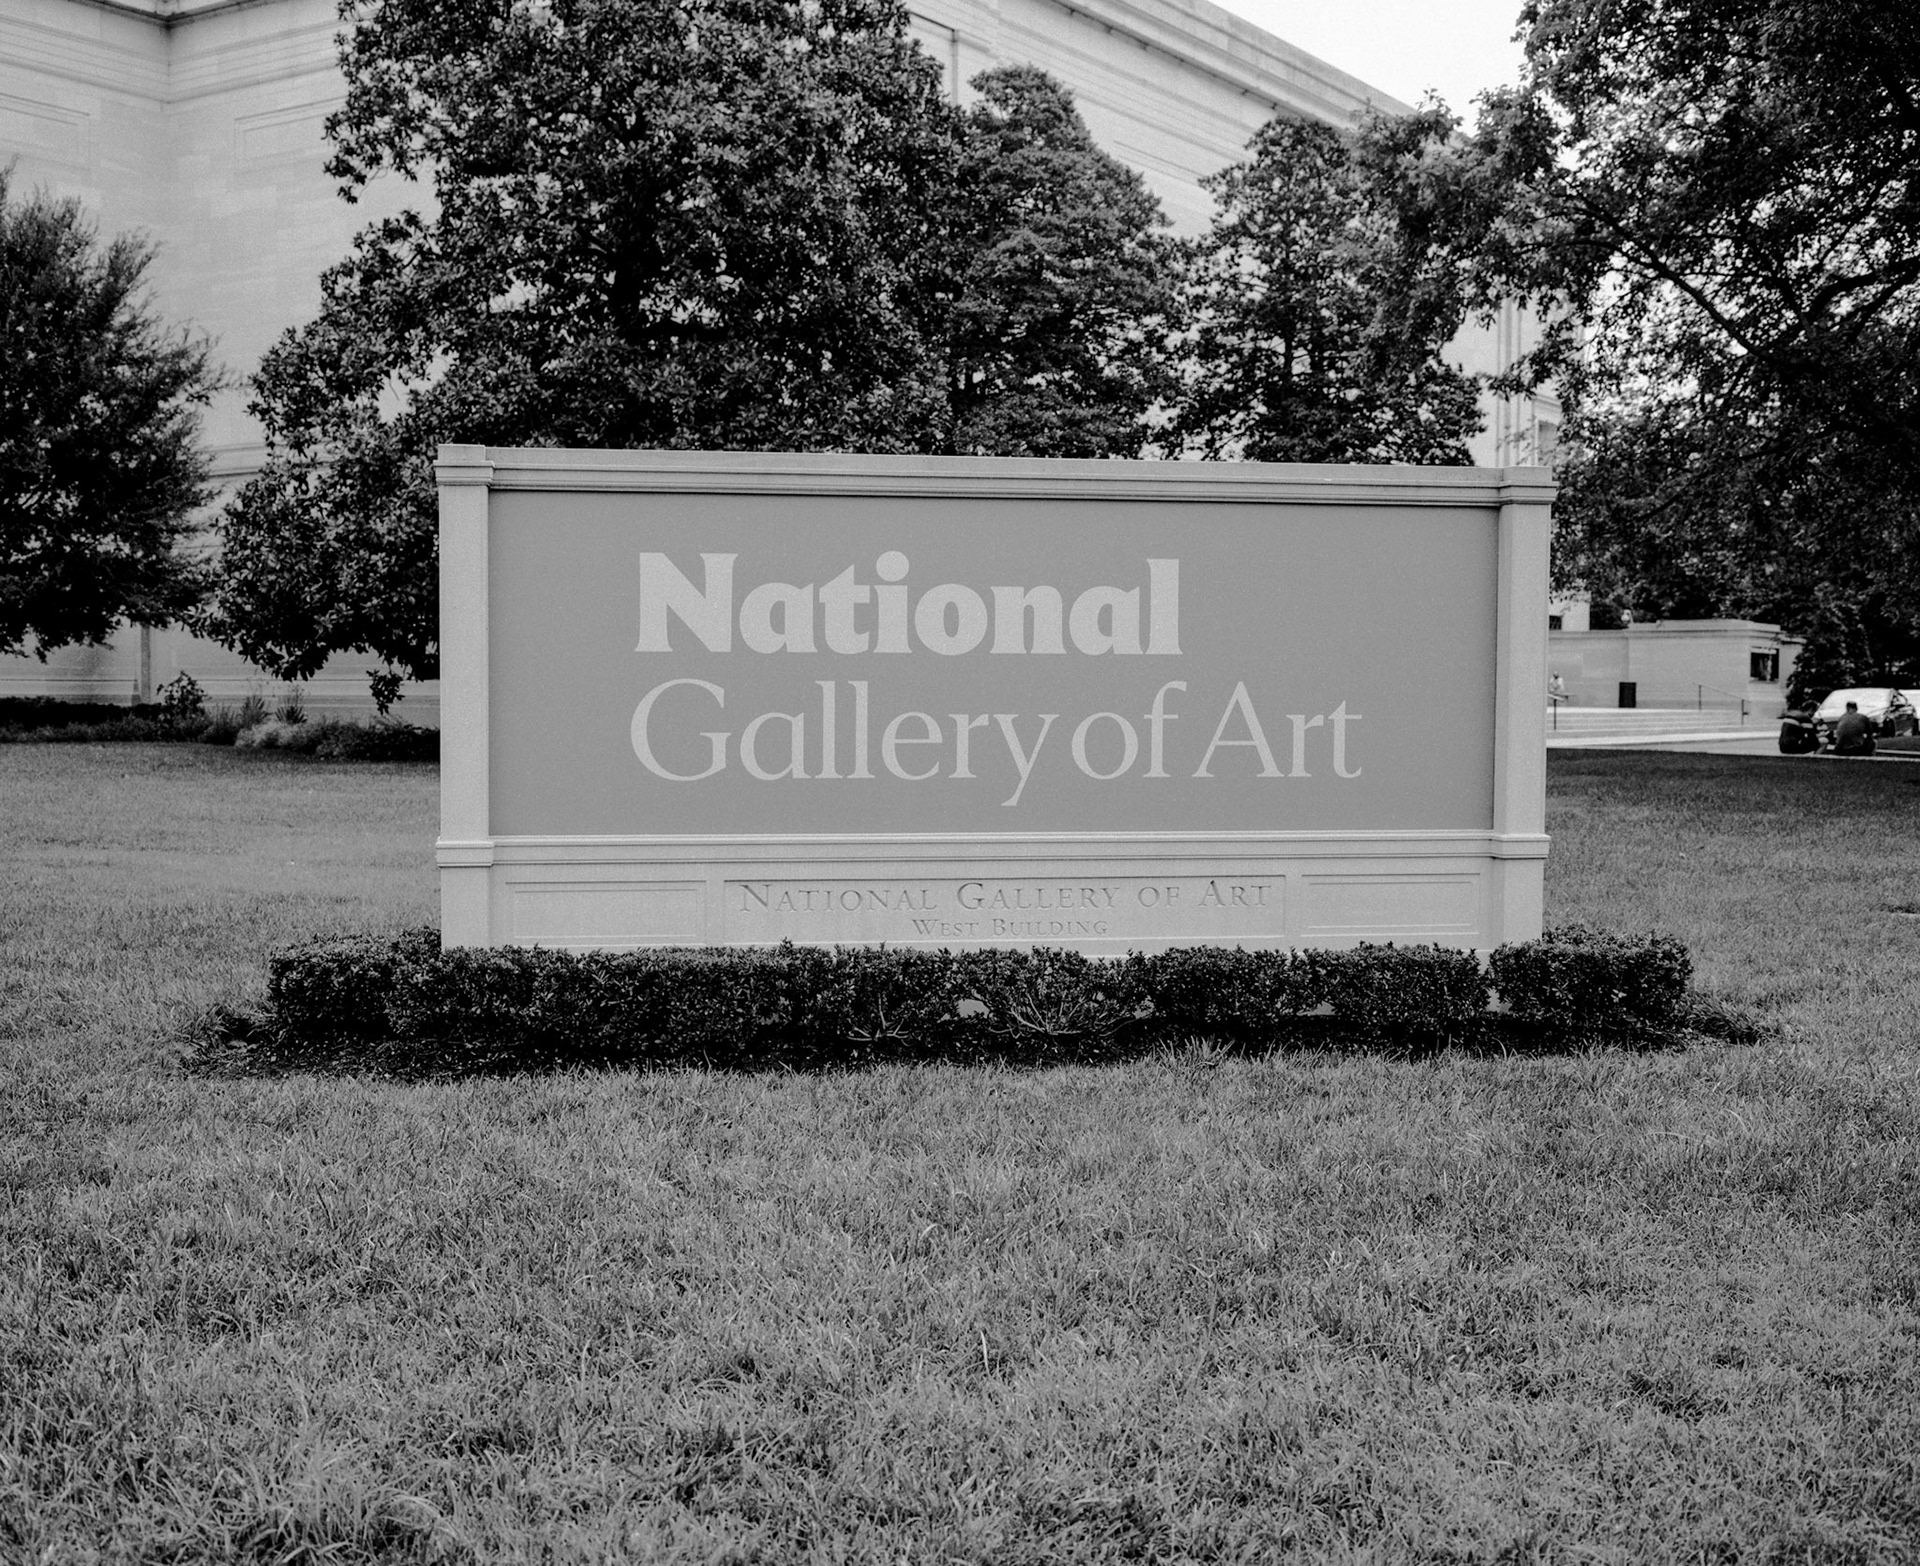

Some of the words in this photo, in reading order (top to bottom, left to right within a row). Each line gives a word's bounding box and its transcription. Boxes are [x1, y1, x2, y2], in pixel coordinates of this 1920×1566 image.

[634, 551, 1183, 656] National
[631, 678, 1060, 807] Gallery
[1071, 680, 1187, 780] of
[1192, 681, 1363, 779] Art
[740, 884, 938, 912] NATIONAL
[957, 882, 1120, 910] GALLERY
[1137, 885, 1180, 908] OF
[1200, 880, 1272, 907] ART
[912, 918, 978, 938] WEST
[992, 918, 1108, 936] BUILDING
